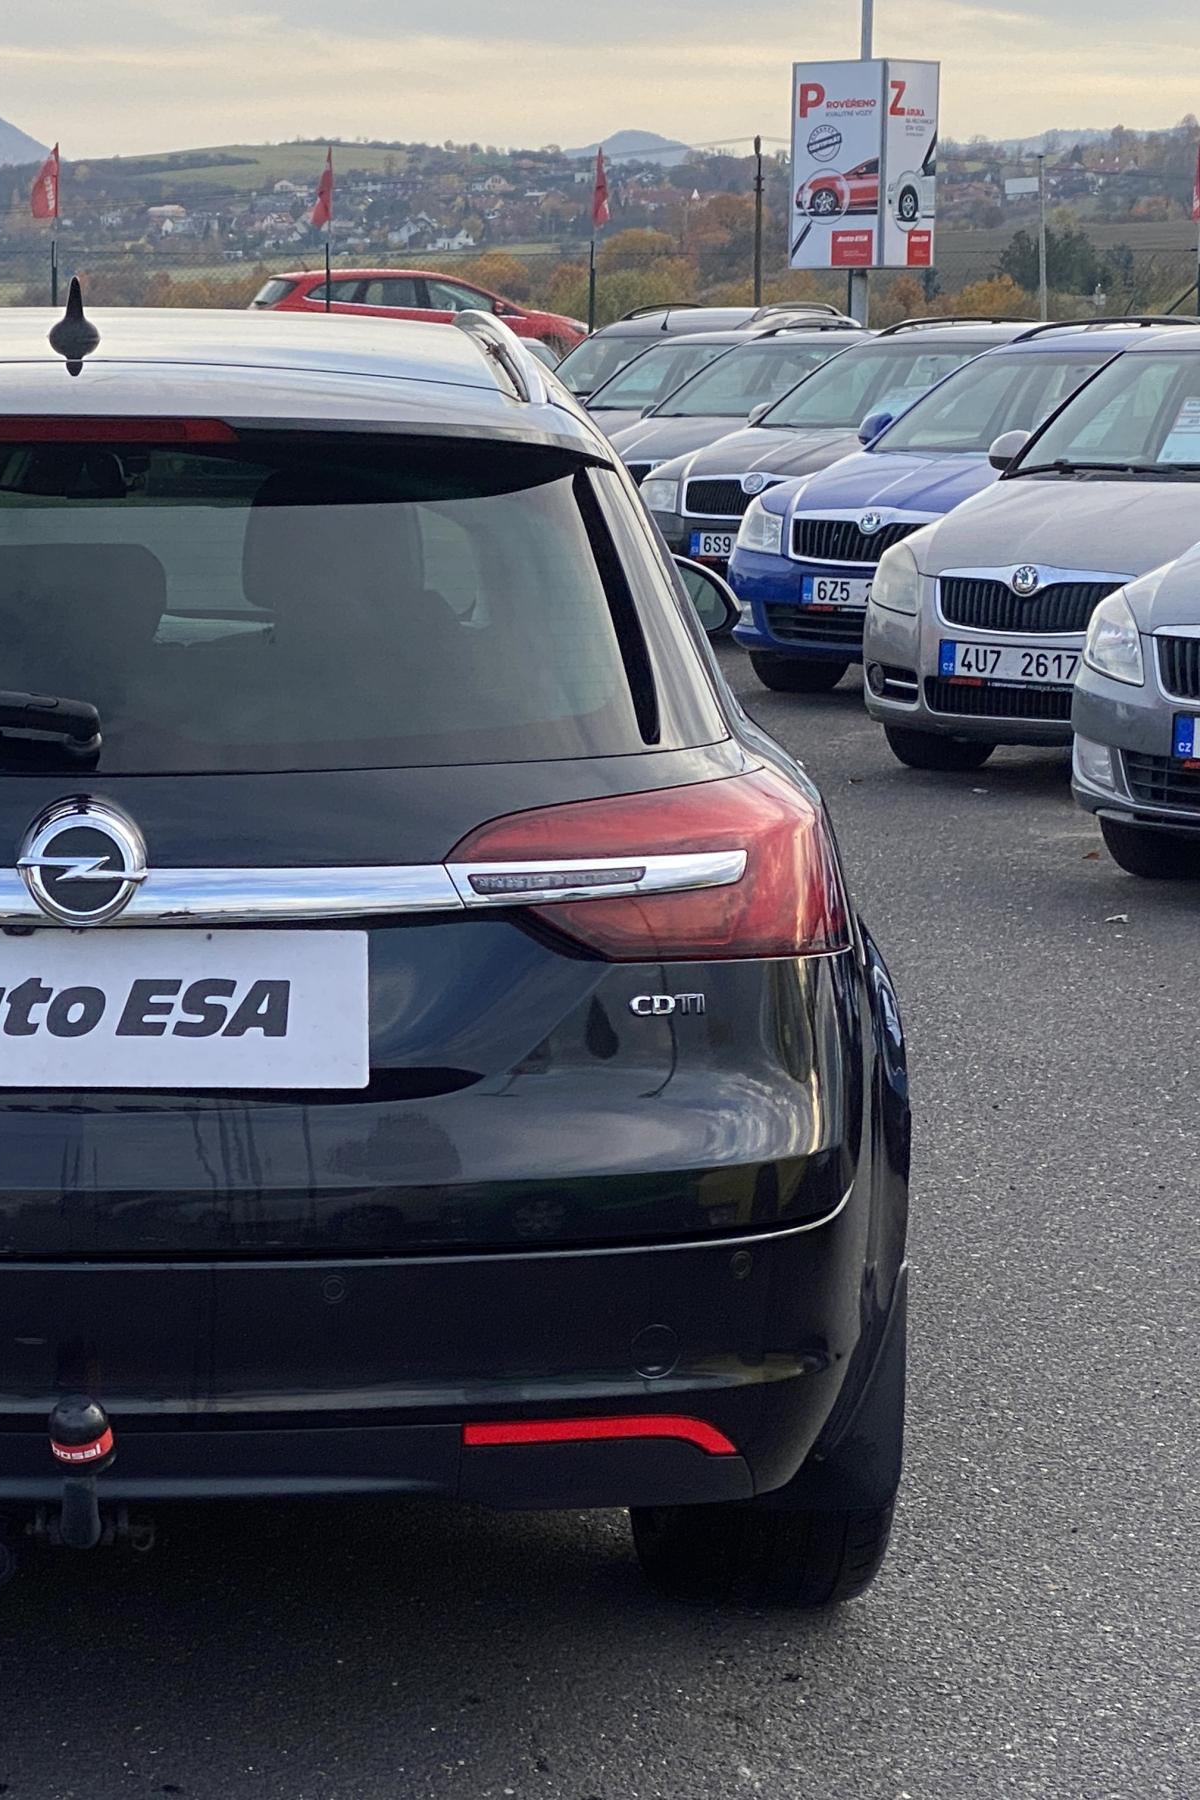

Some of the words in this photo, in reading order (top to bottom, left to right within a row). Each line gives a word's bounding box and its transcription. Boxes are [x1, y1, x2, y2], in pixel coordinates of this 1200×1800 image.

[703, 535, 731, 553] 6S9
[817, 581, 850, 602] 6Z5
[961, 647, 1002, 674] 4U7
[1020, 652, 1079, 680] 2617
[1178, 742, 1192, 753] CZ
[115, 978, 291, 1038] ESA
[629, 993, 706, 1016] CDTI
[51, 1440, 101, 1460] bosal
